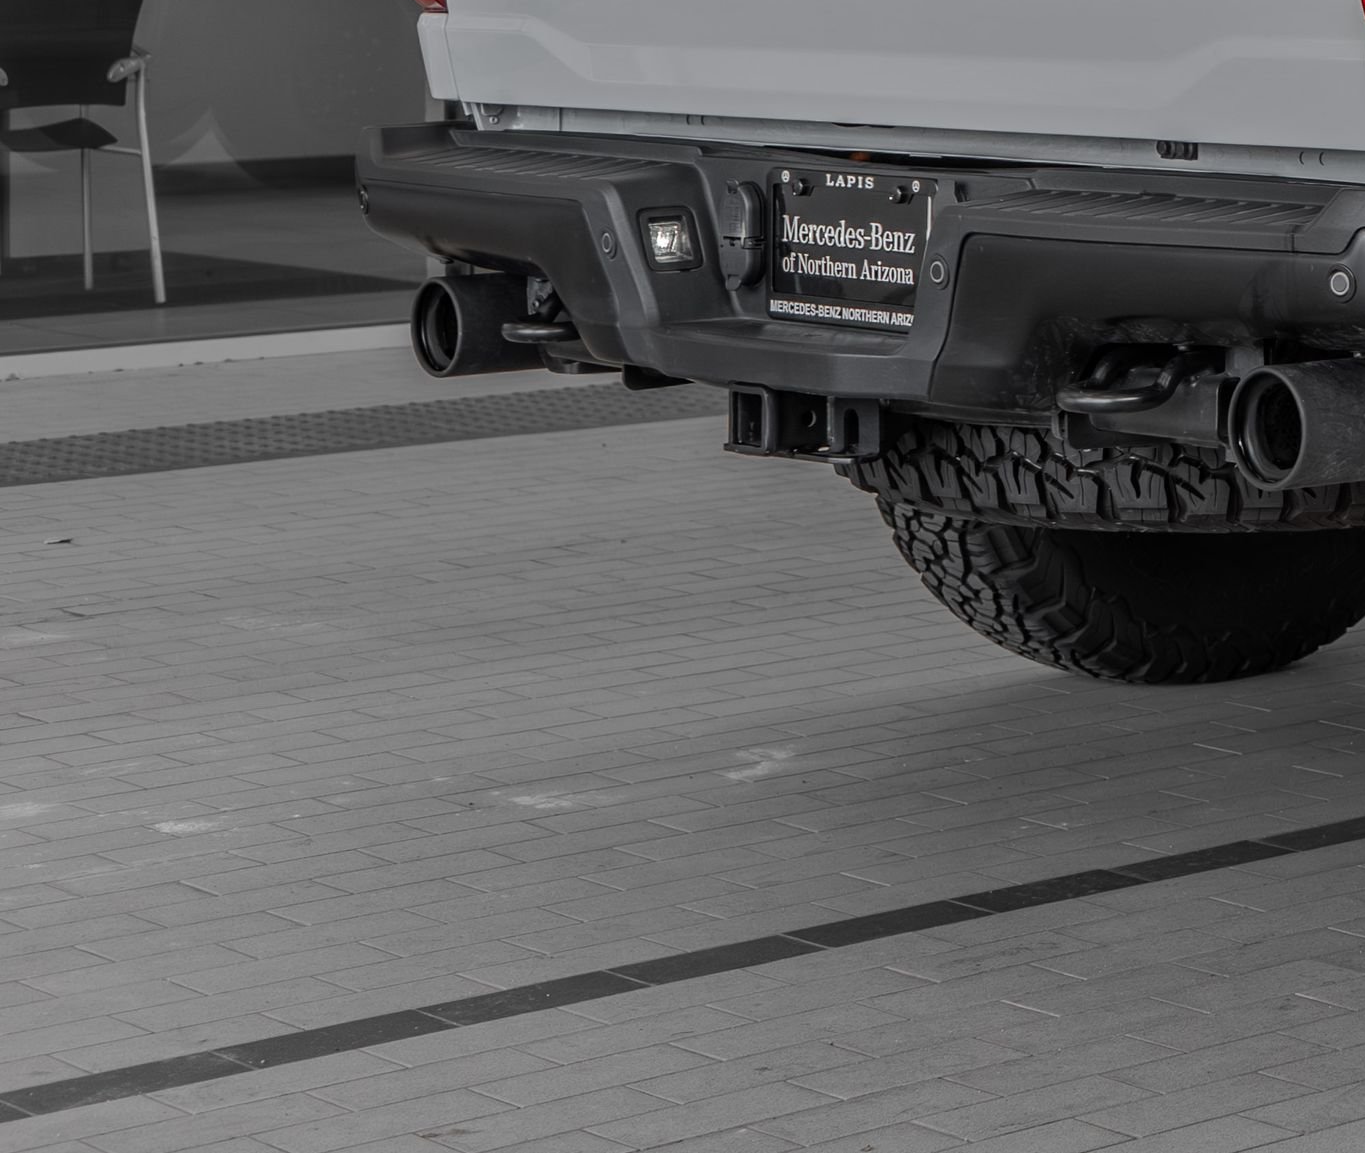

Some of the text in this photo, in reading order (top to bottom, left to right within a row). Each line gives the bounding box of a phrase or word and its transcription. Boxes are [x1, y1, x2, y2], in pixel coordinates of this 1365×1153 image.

[825, 173, 875, 189] LAPIS
[782, 214, 916, 254] Mercedes-Benz
[782, 253, 915, 285] of Northern Arizona
[770, 299, 914, 327] MERCEDES-BENZ NORTHERN ARIZ
